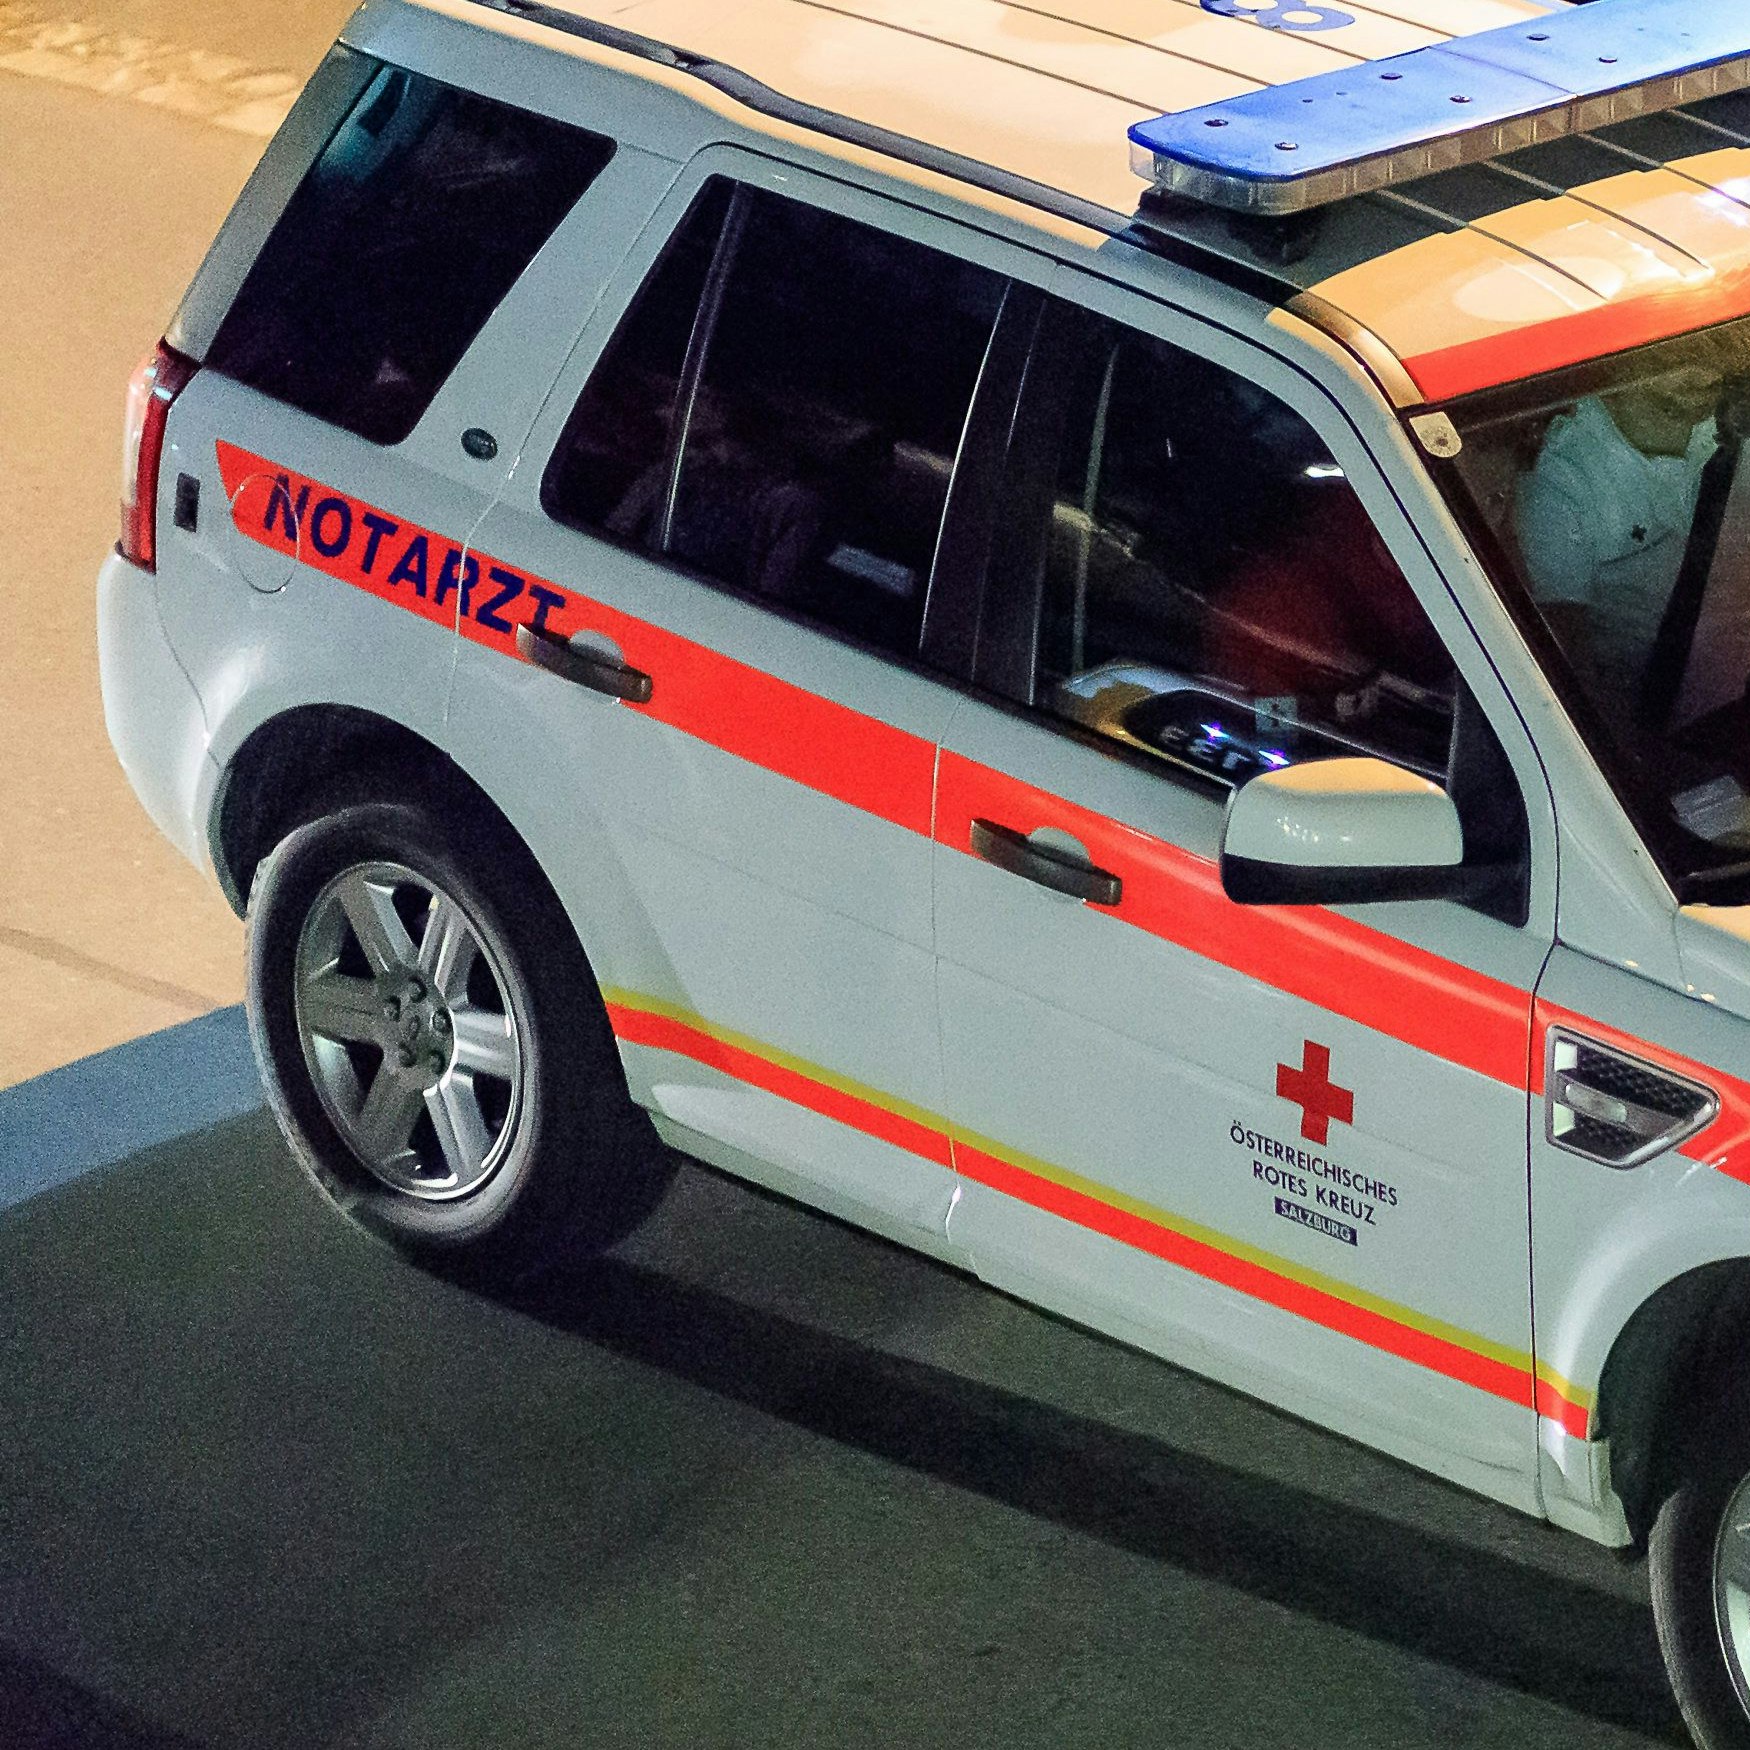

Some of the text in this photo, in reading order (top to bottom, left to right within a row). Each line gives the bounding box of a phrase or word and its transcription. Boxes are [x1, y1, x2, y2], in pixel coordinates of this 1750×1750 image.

[264, 474, 566, 634] NOTARZT
[1230, 1120, 1397, 1206] ÖSTERREICHISCHES
[1252, 1159, 1377, 1226] ROTES KREUZ
[1279, 1200, 1352, 1241] SALZBURG
